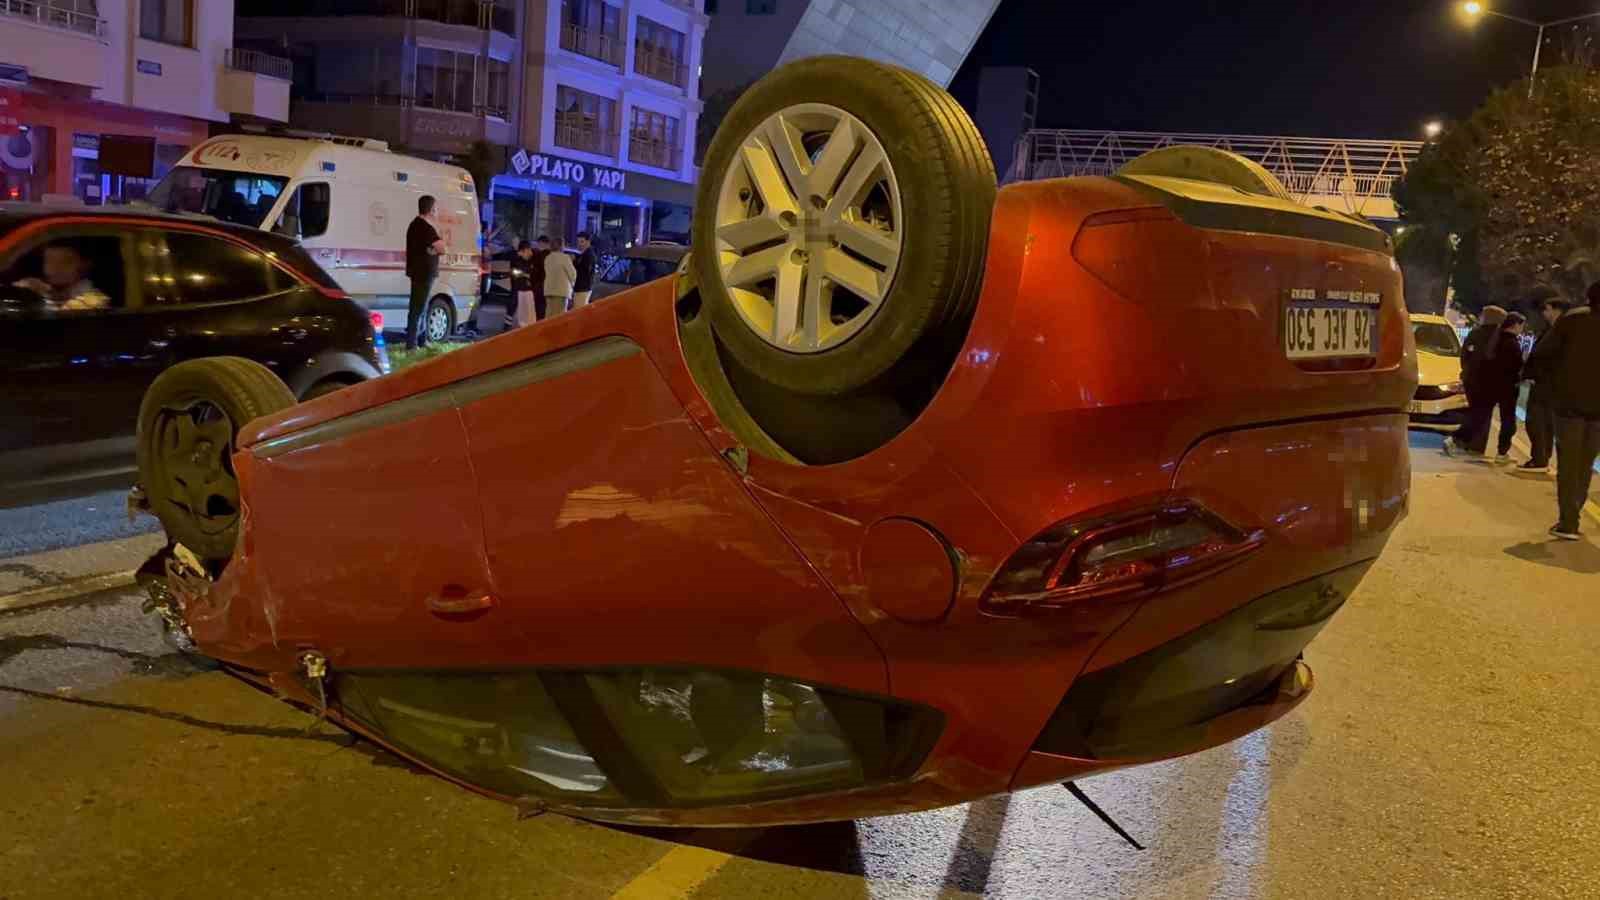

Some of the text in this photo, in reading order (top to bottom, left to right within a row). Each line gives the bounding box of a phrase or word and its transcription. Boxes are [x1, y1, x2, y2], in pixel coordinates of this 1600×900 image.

[530, 154, 625, 190] PLATO YAPI
[1287, 308, 1316, 352] 530
[1355, 310, 1369, 350] 26
